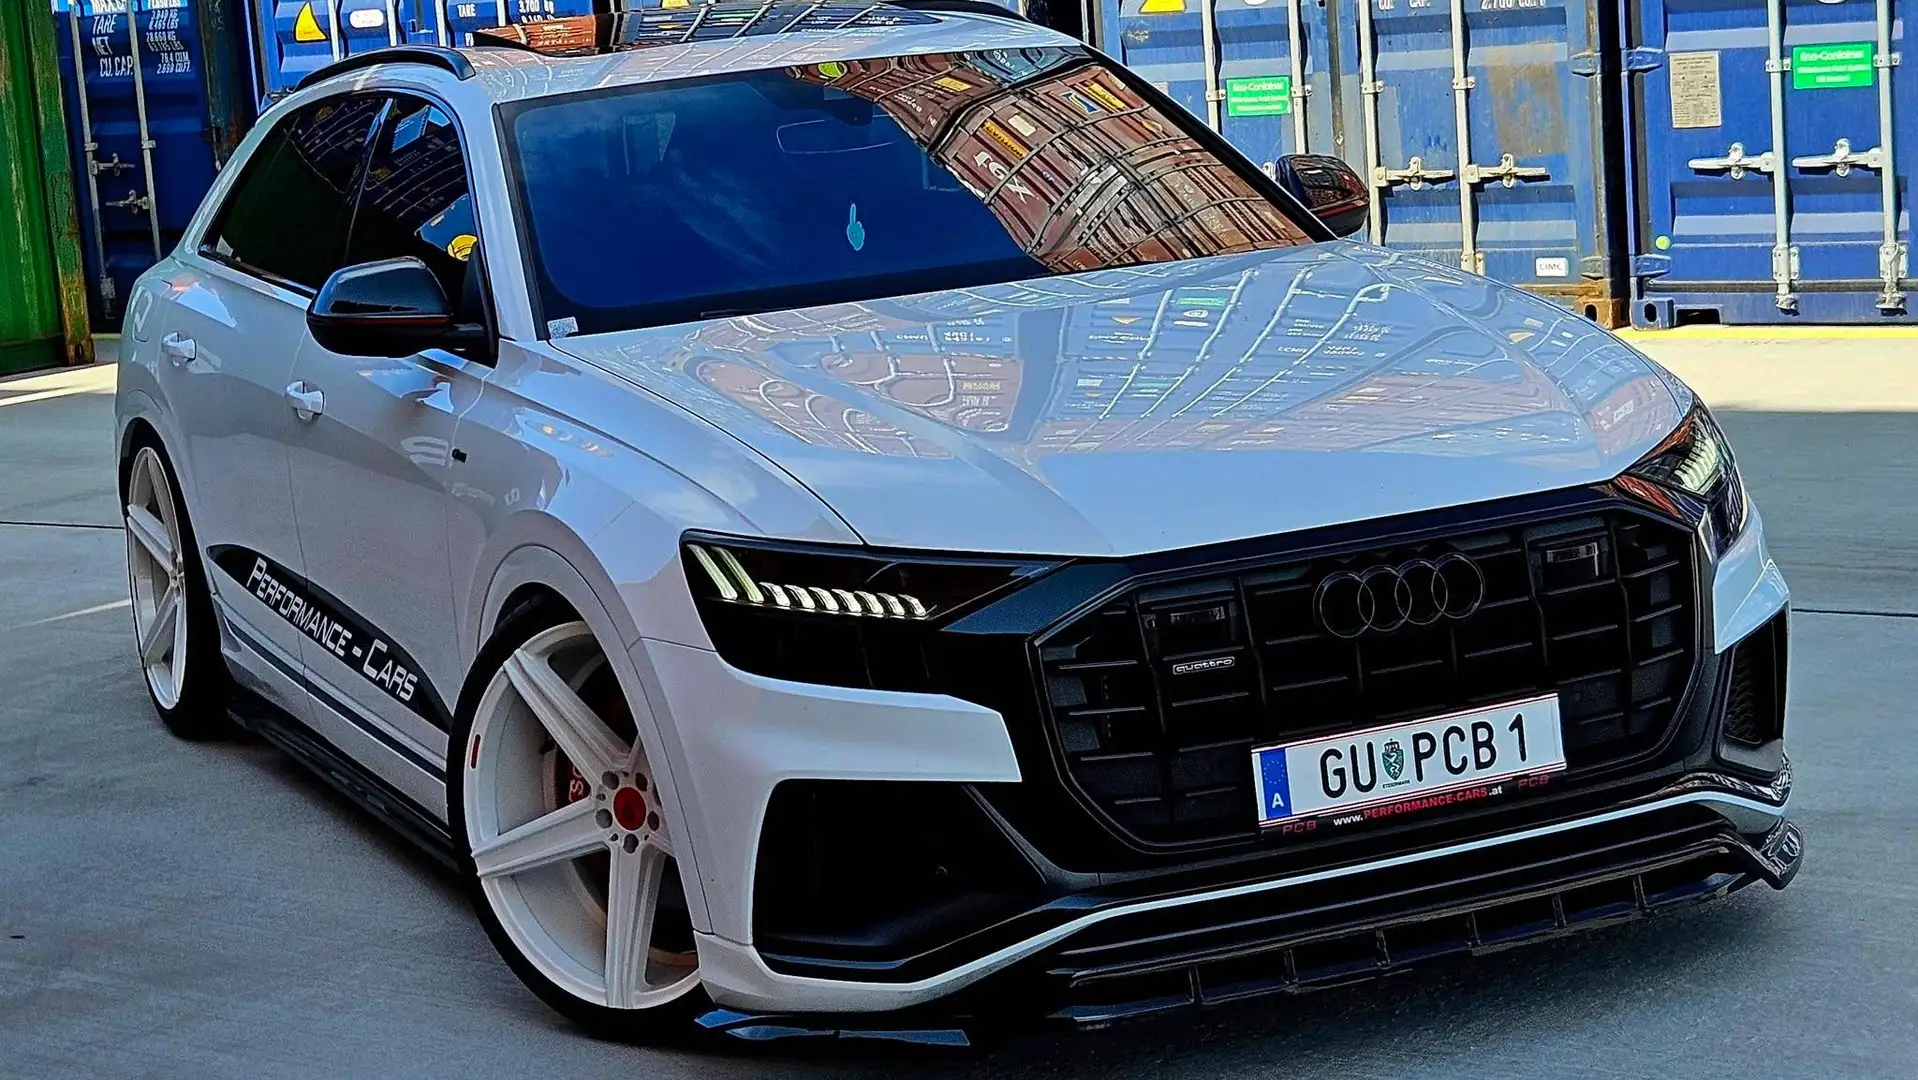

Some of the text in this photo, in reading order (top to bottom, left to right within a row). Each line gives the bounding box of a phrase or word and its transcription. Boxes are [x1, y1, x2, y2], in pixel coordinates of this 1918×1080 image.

[457, 4, 476, 17] TARE
[92, 14, 117, 35] TARE
[92, 36, 113, 56] NET
[246, 557, 352, 657] PERFORMANCE
[1175, 659, 1233, 675] quattro
[1319, 713, 1527, 799] GU PCB 1
[1271, 792, 1285, 808] A
